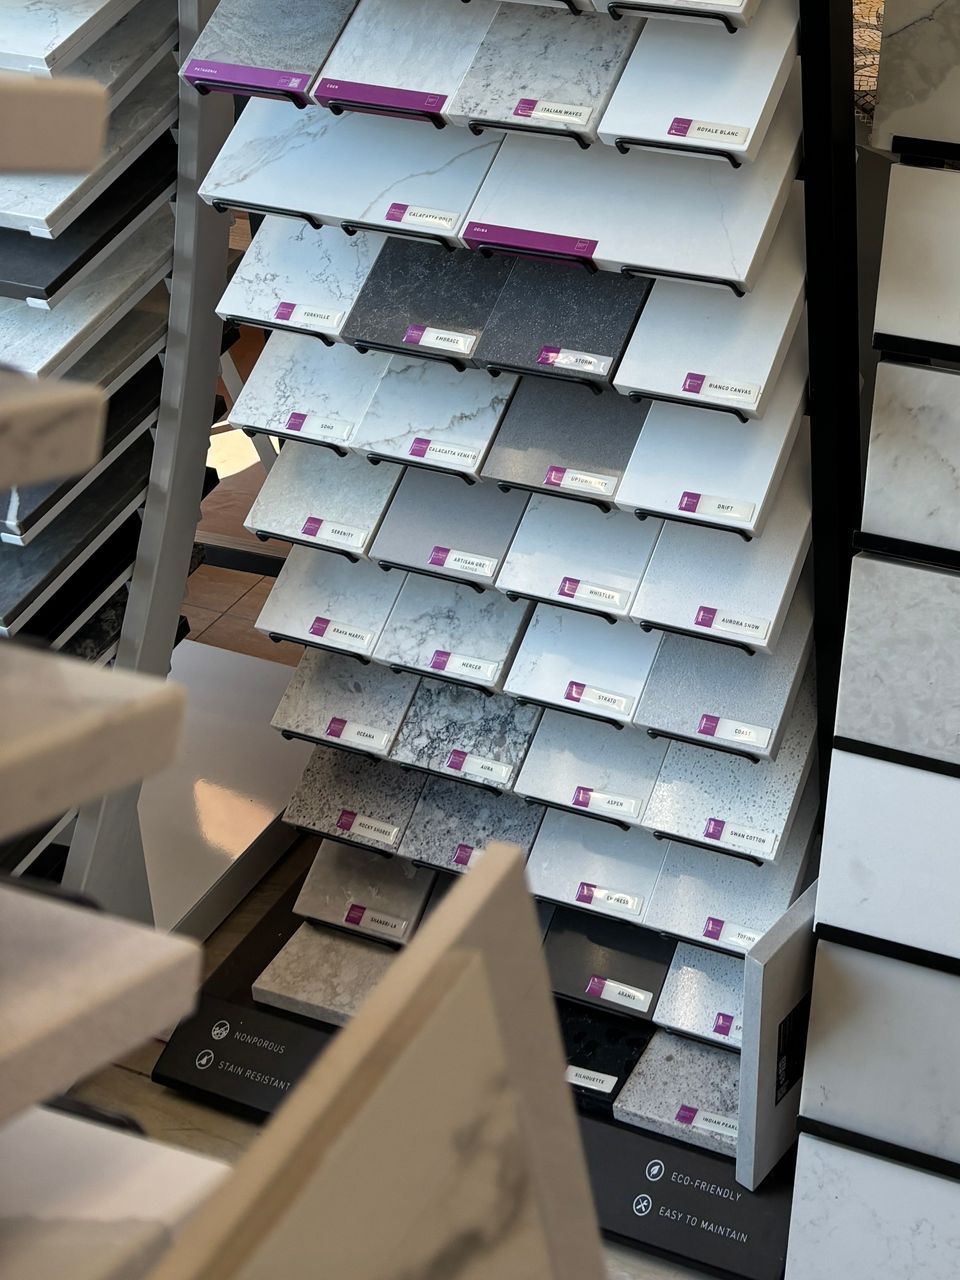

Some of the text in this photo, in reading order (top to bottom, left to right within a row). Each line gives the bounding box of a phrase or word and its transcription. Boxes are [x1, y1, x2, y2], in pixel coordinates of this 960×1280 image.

[541, 107, 563, 115] ITALIAN
[563, 108, 583, 117] WAVES
[696, 126, 718, 134] ROYALE
[718, 129, 739, 137] BLANC
[303, 311, 330, 320] YORKVILLE
[435, 336, 460, 344] EMBRACE
[575, 357, 593, 365] STORM
[708, 383, 752, 396] BIANCO CANVAS
[428, 446, 456, 456] CALACATTA
[717, 503, 734, 511] DRIFT
[331, 528, 354, 538] SERENITY
[454, 557, 475, 566] ARTISAN
[589, 589, 615, 600] WHISTLER
[721, 617, 760, 630] AURORA SNOW
[462, 661, 482, 670] MERCER
[598, 695, 617, 704] STRATO
[356, 730, 375, 739] OCEANA
[735, 728, 752, 736] COAST
[480, 764, 494, 772] AURA
[606, 799, 623, 807] ASPEN
[358, 821, 391, 836] ROCKY SHORES
[730, 830, 766, 844] SWAN COTTON
[737, 932, 756, 942] TOFINO
[234, 1031, 286, 1054] NONPOROUS
[218, 1060, 291, 1090] STAIN RESISTANT
[575, 1073, 605, 1084] SILHOUETTE
[702, 1117, 738, 1130] INDIAN PEARL
[671, 1171, 742, 1202] ECO-FRIENDLY
[659, 1206, 748, 1243] EASY TO MAINTAIN
